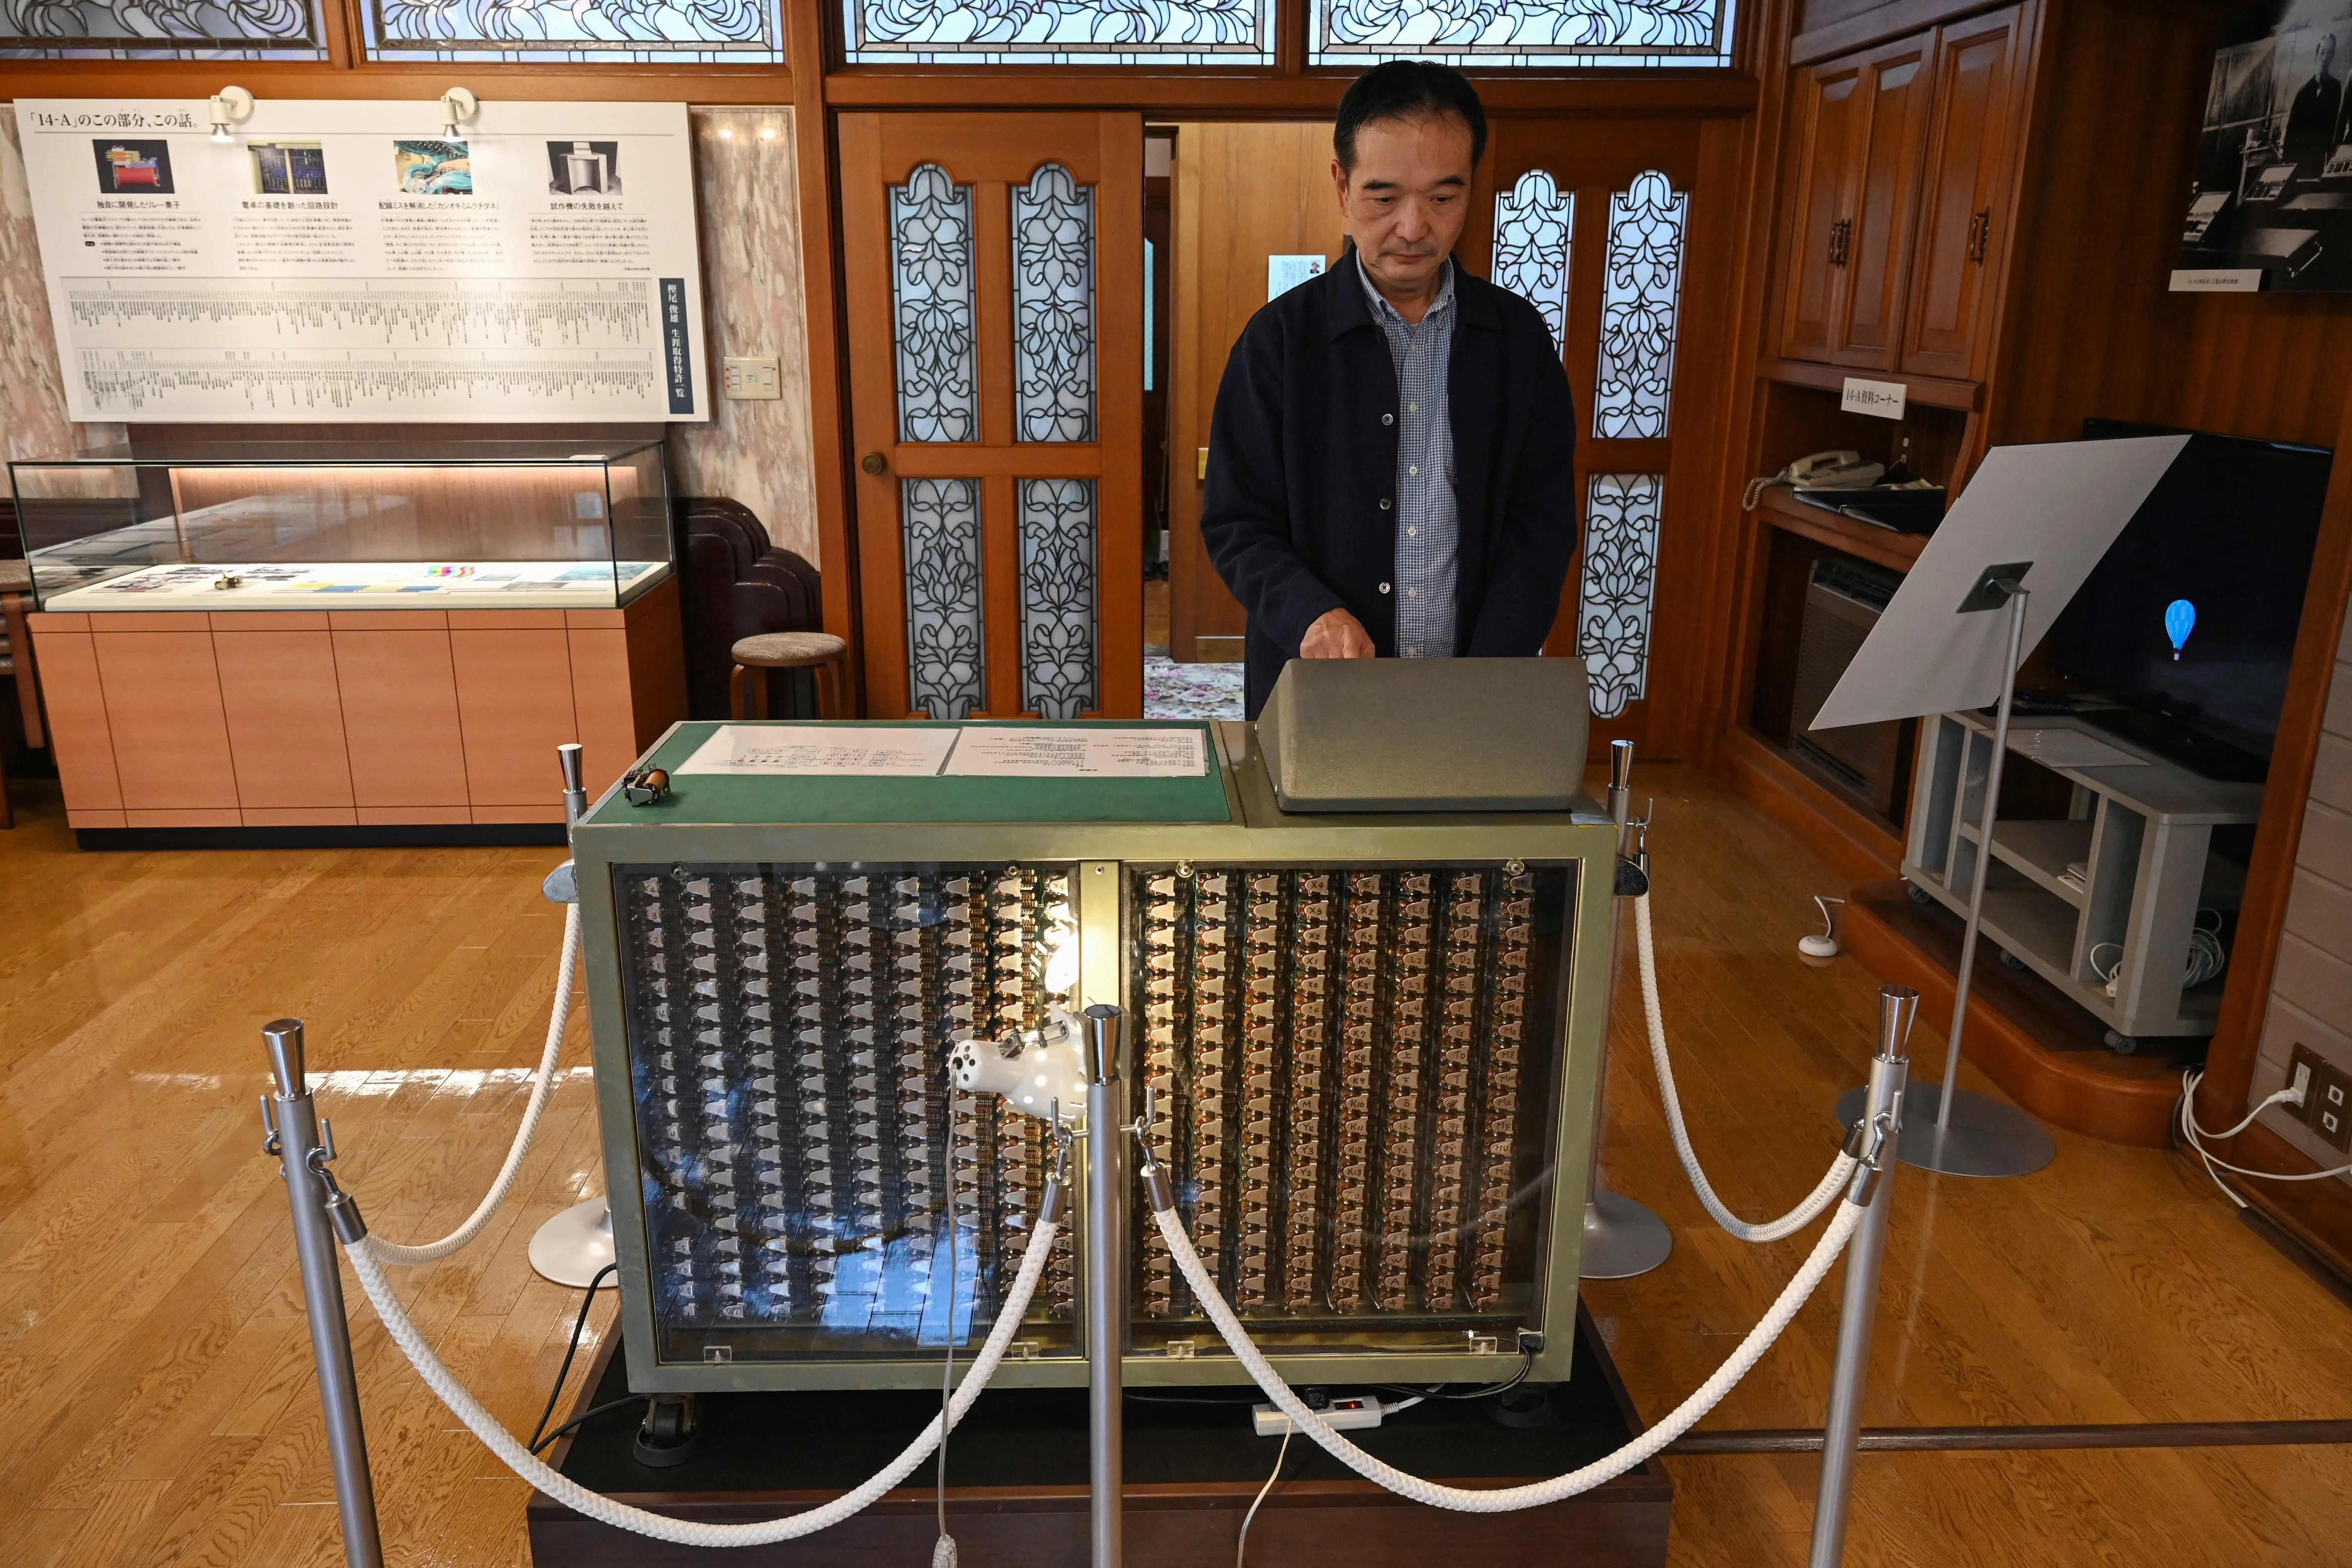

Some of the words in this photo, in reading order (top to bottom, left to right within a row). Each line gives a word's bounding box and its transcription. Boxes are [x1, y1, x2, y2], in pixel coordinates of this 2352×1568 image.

[30, 112, 198, 128] 「14-A」のこの部分、この話。
[97, 201, 180, 209] 独自に開発したリレー素子
[241, 201, 338, 209] 電卓の基礎を創った回路設計
[379, 202, 499, 210] 配線ミスを解消した「カシオキミムクチダネ」
[550, 202, 623, 210] 試作機の失敗を越えて
[671, 328, 685, 398] 生涯取得特許一覧
[1364, 881, 1374, 890] K1
[1362, 906, 1374, 914] K2
[1513, 905, 1526, 913] M2
[1361, 932, 1372, 940] K3
[1354, 1053, 1365, 1062] K8
[1303, 1123, 1314, 1132] Y4
[1302, 1146, 1313, 1155] Y3
[1444, 1144, 1457, 1154] 除
[1059, 1240, 1070, 1248] Z5
[1060, 1262, 1070, 1271] Y5
